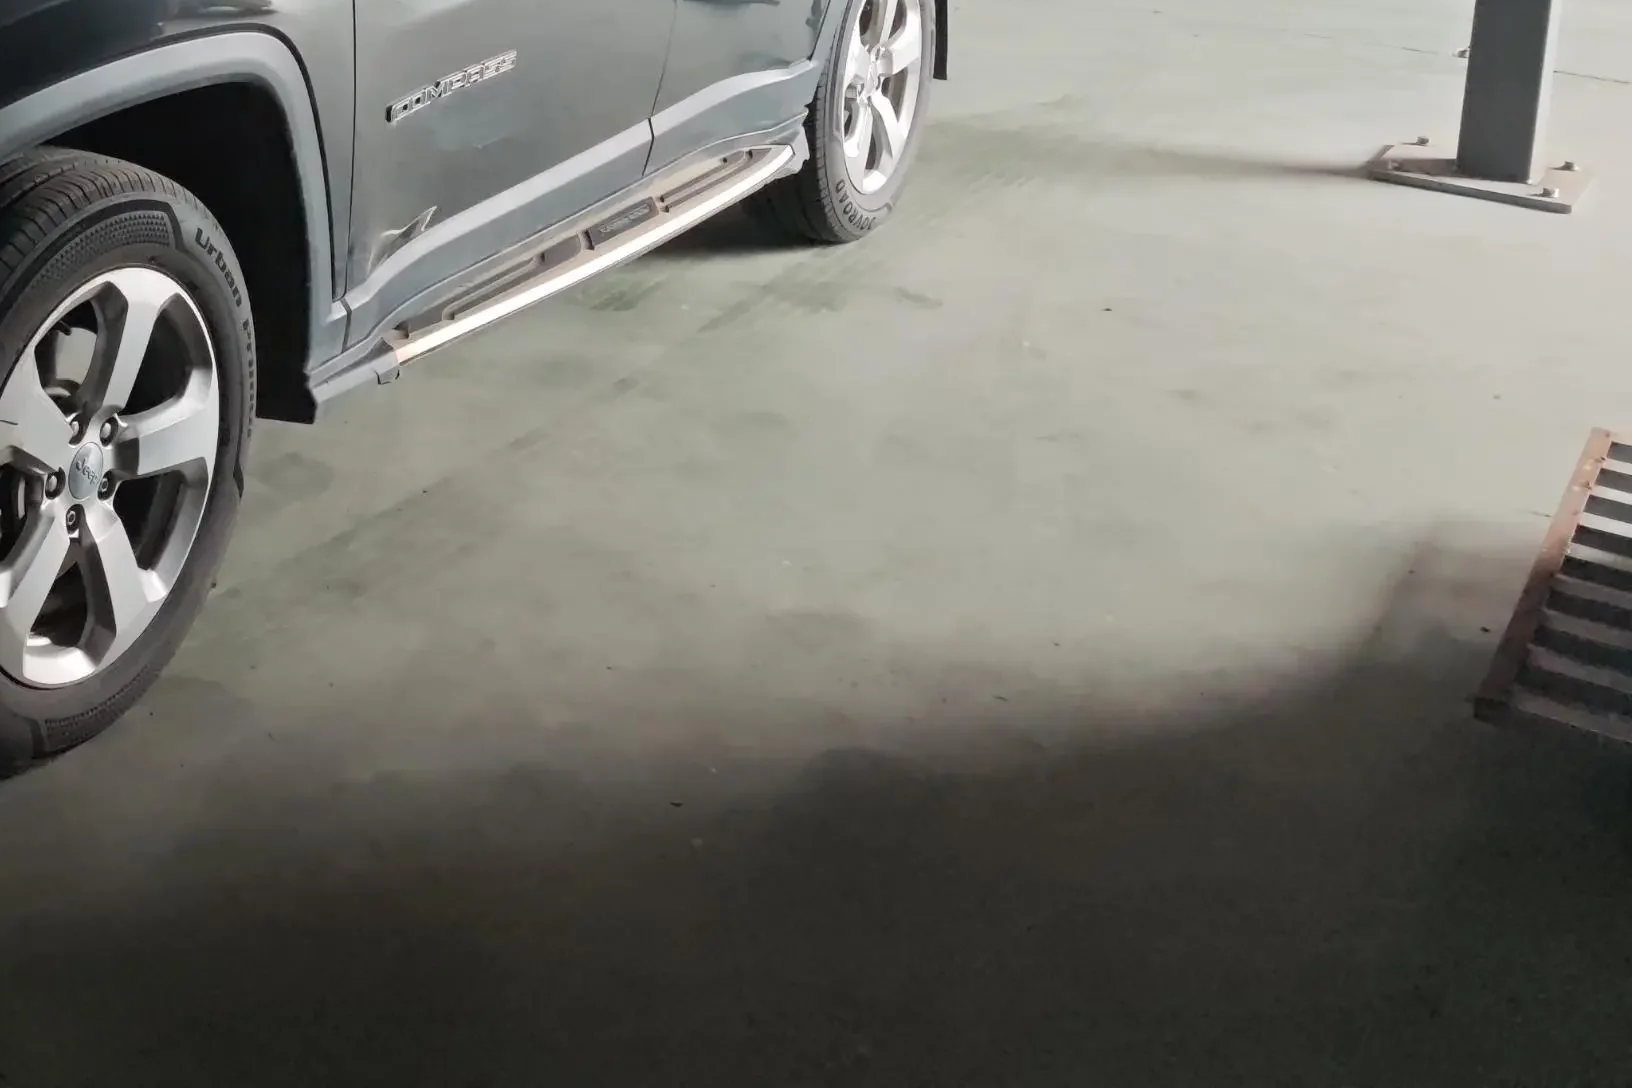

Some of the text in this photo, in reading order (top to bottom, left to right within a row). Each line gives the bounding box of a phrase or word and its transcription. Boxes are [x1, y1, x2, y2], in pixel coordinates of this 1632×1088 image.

[384, 48, 518, 124] COMPASS
[195, 227, 243, 308] Urban
[74, 458, 99, 485] Jeep
